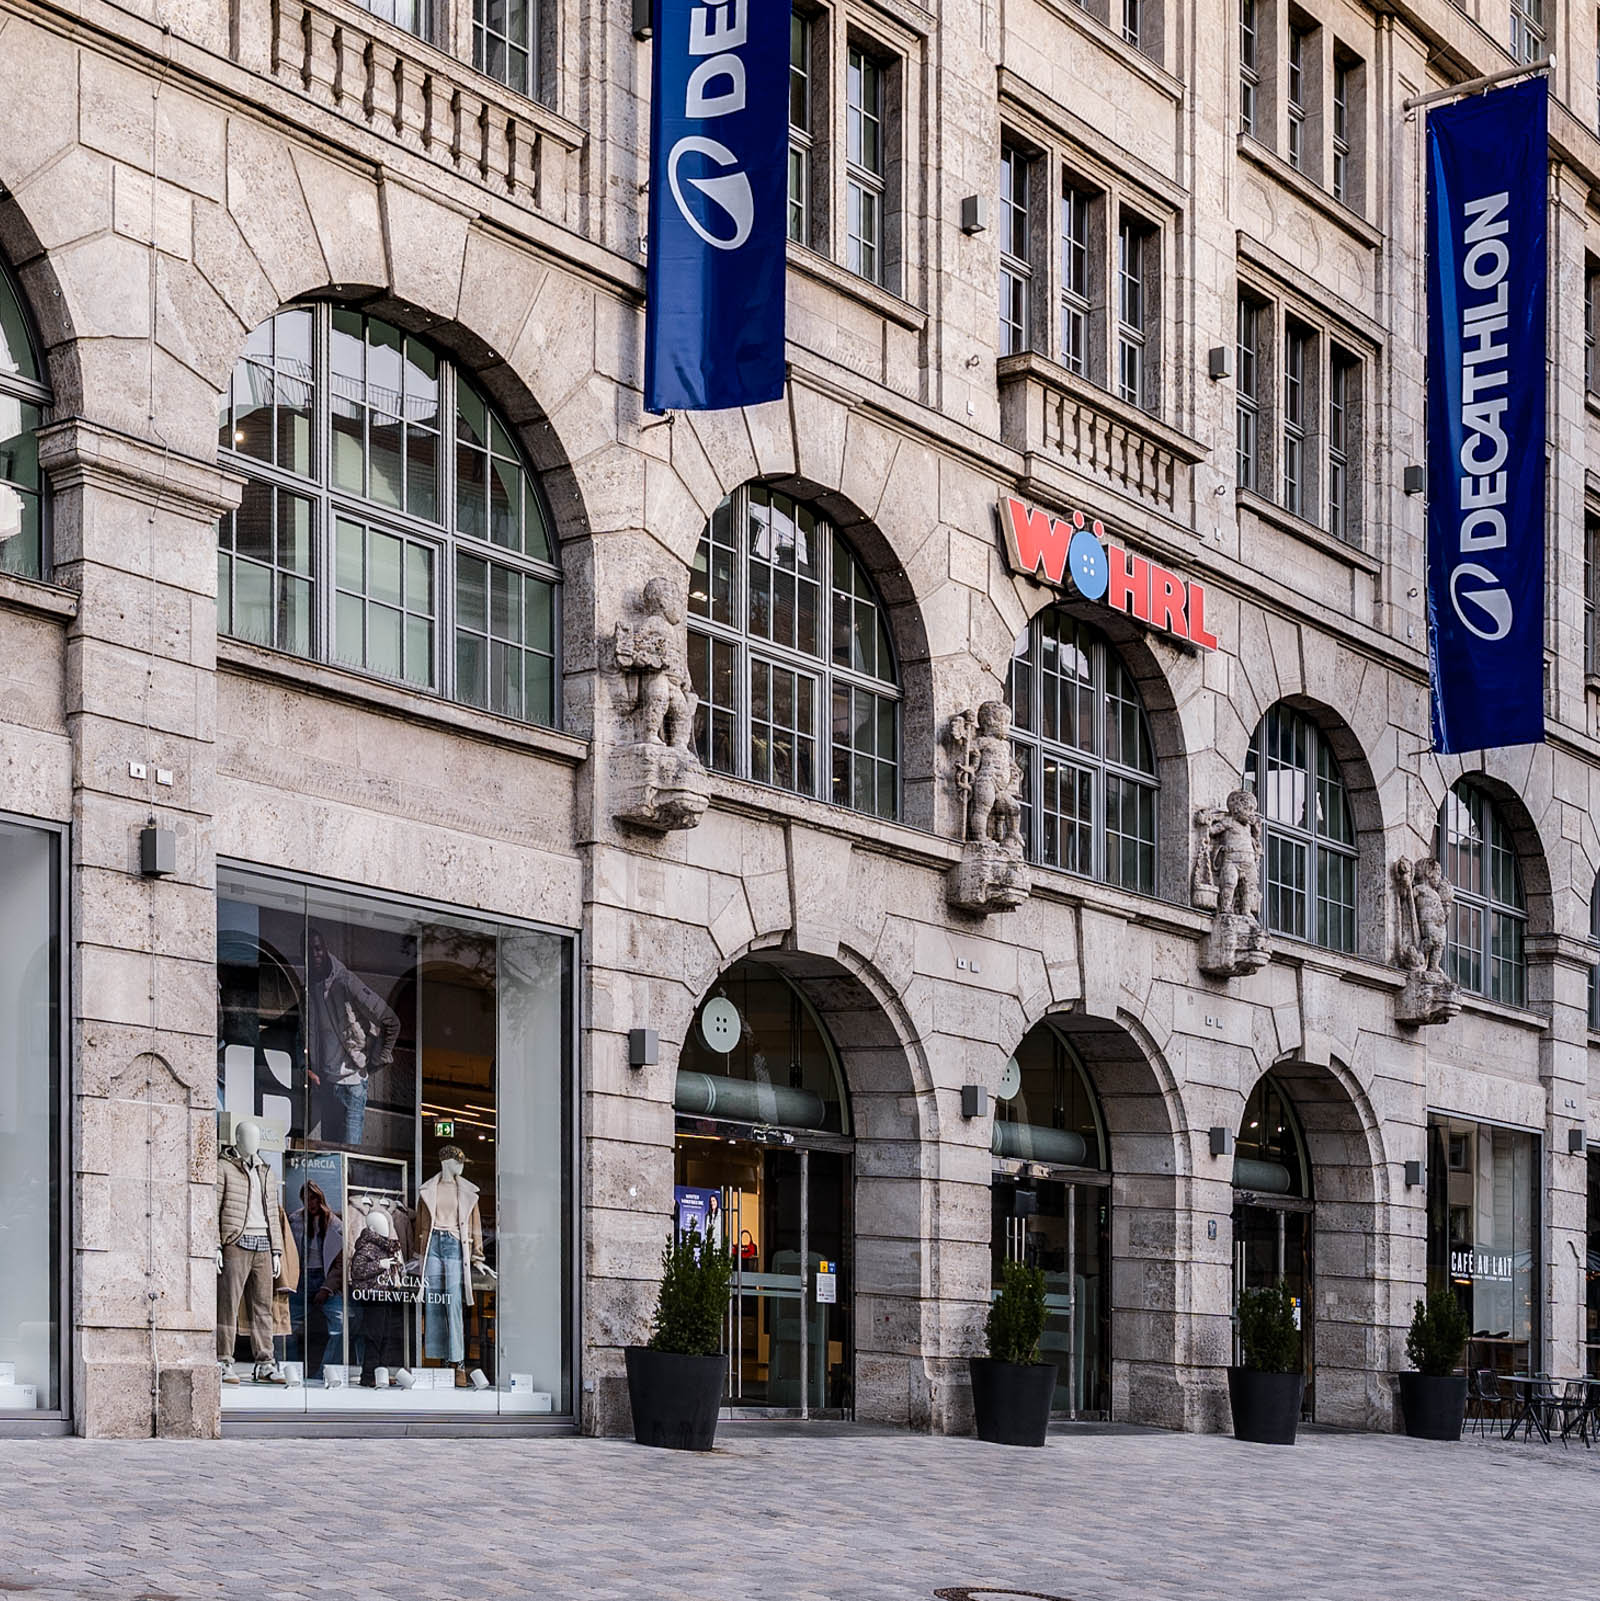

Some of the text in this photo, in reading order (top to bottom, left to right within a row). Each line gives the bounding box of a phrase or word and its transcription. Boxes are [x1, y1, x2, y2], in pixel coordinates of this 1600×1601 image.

[1461, 191, 1510, 552] DECATHLON
[1004, 496, 1218, 651] WÖHRL
[301, 1159, 336, 1170] GARCIA
[1451, 1250, 1474, 1273] CAFÉ
[1477, 1255, 1489, 1275] AU
[1492, 1255, 1513, 1277] LAIT
[352, 1288, 453, 1305] OUTERWEAR EDIT
